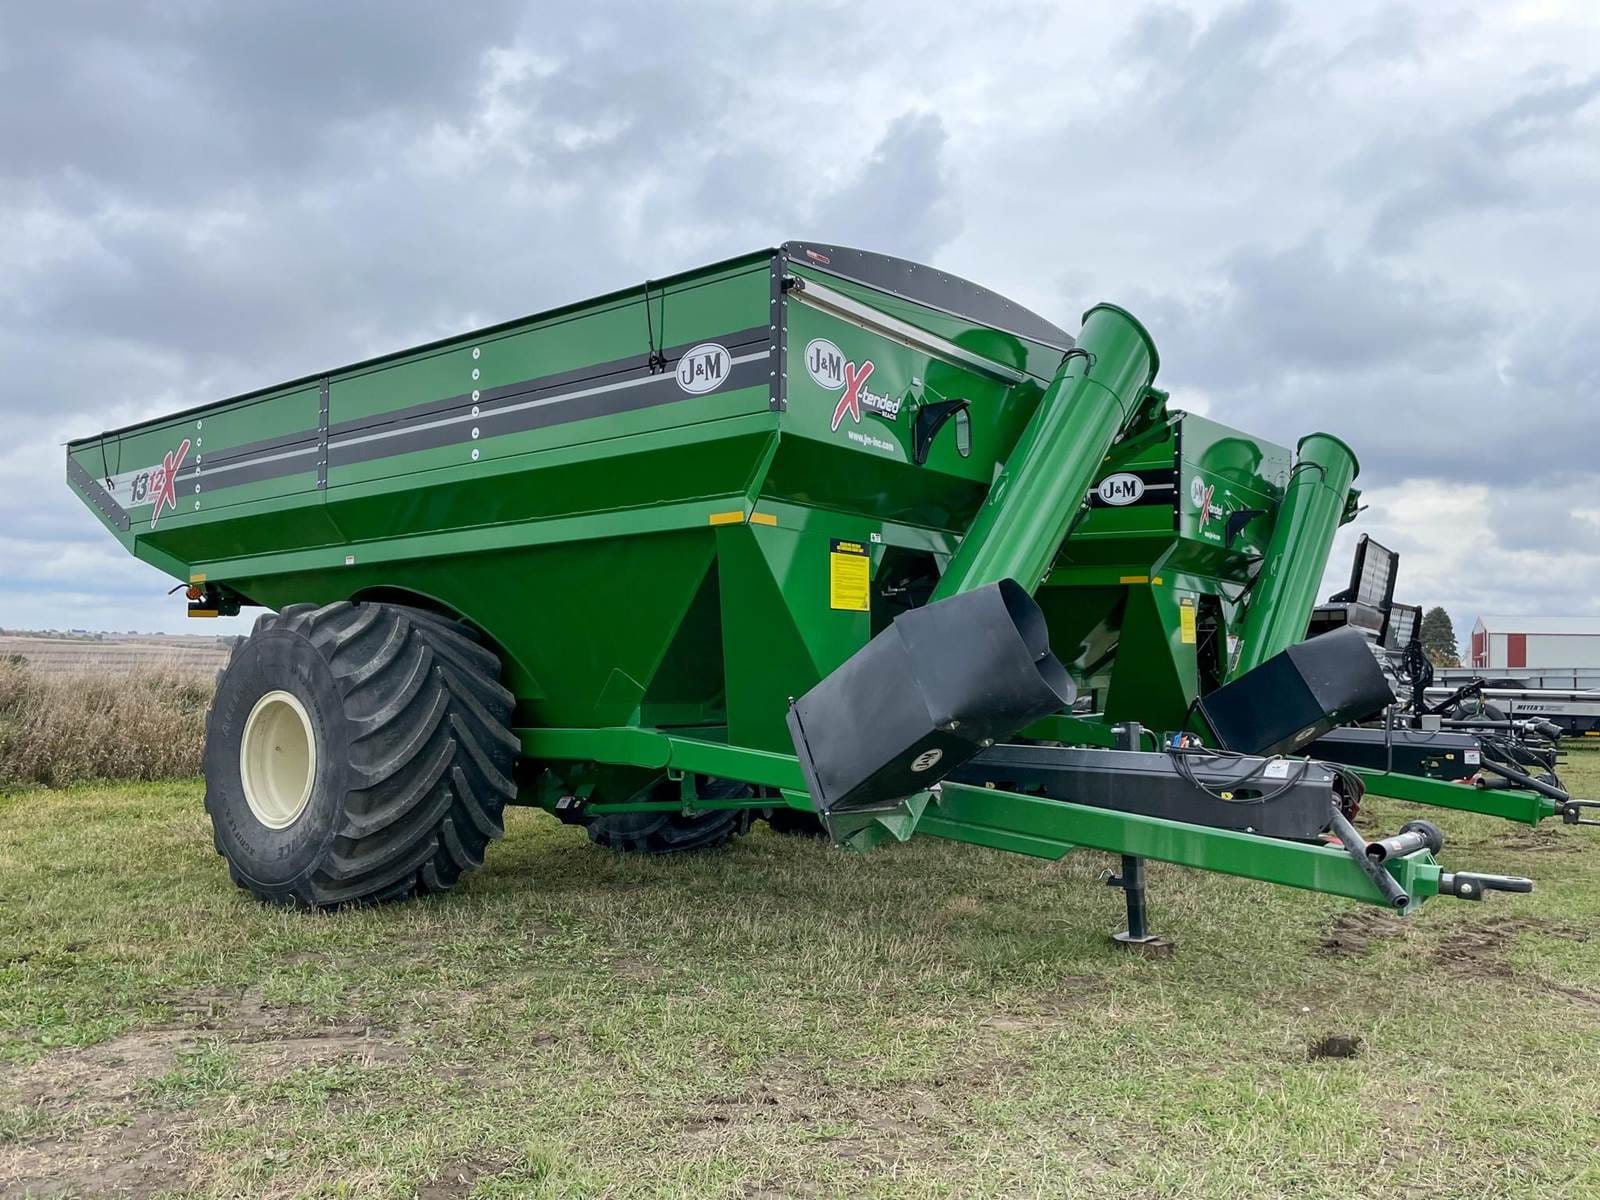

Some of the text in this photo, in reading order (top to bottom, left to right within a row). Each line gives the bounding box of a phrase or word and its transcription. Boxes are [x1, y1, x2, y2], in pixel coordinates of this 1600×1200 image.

[682, 351, 721, 385] J&M
[810, 347, 842, 382] J&M
[1103, 480, 1136, 499] J&M
